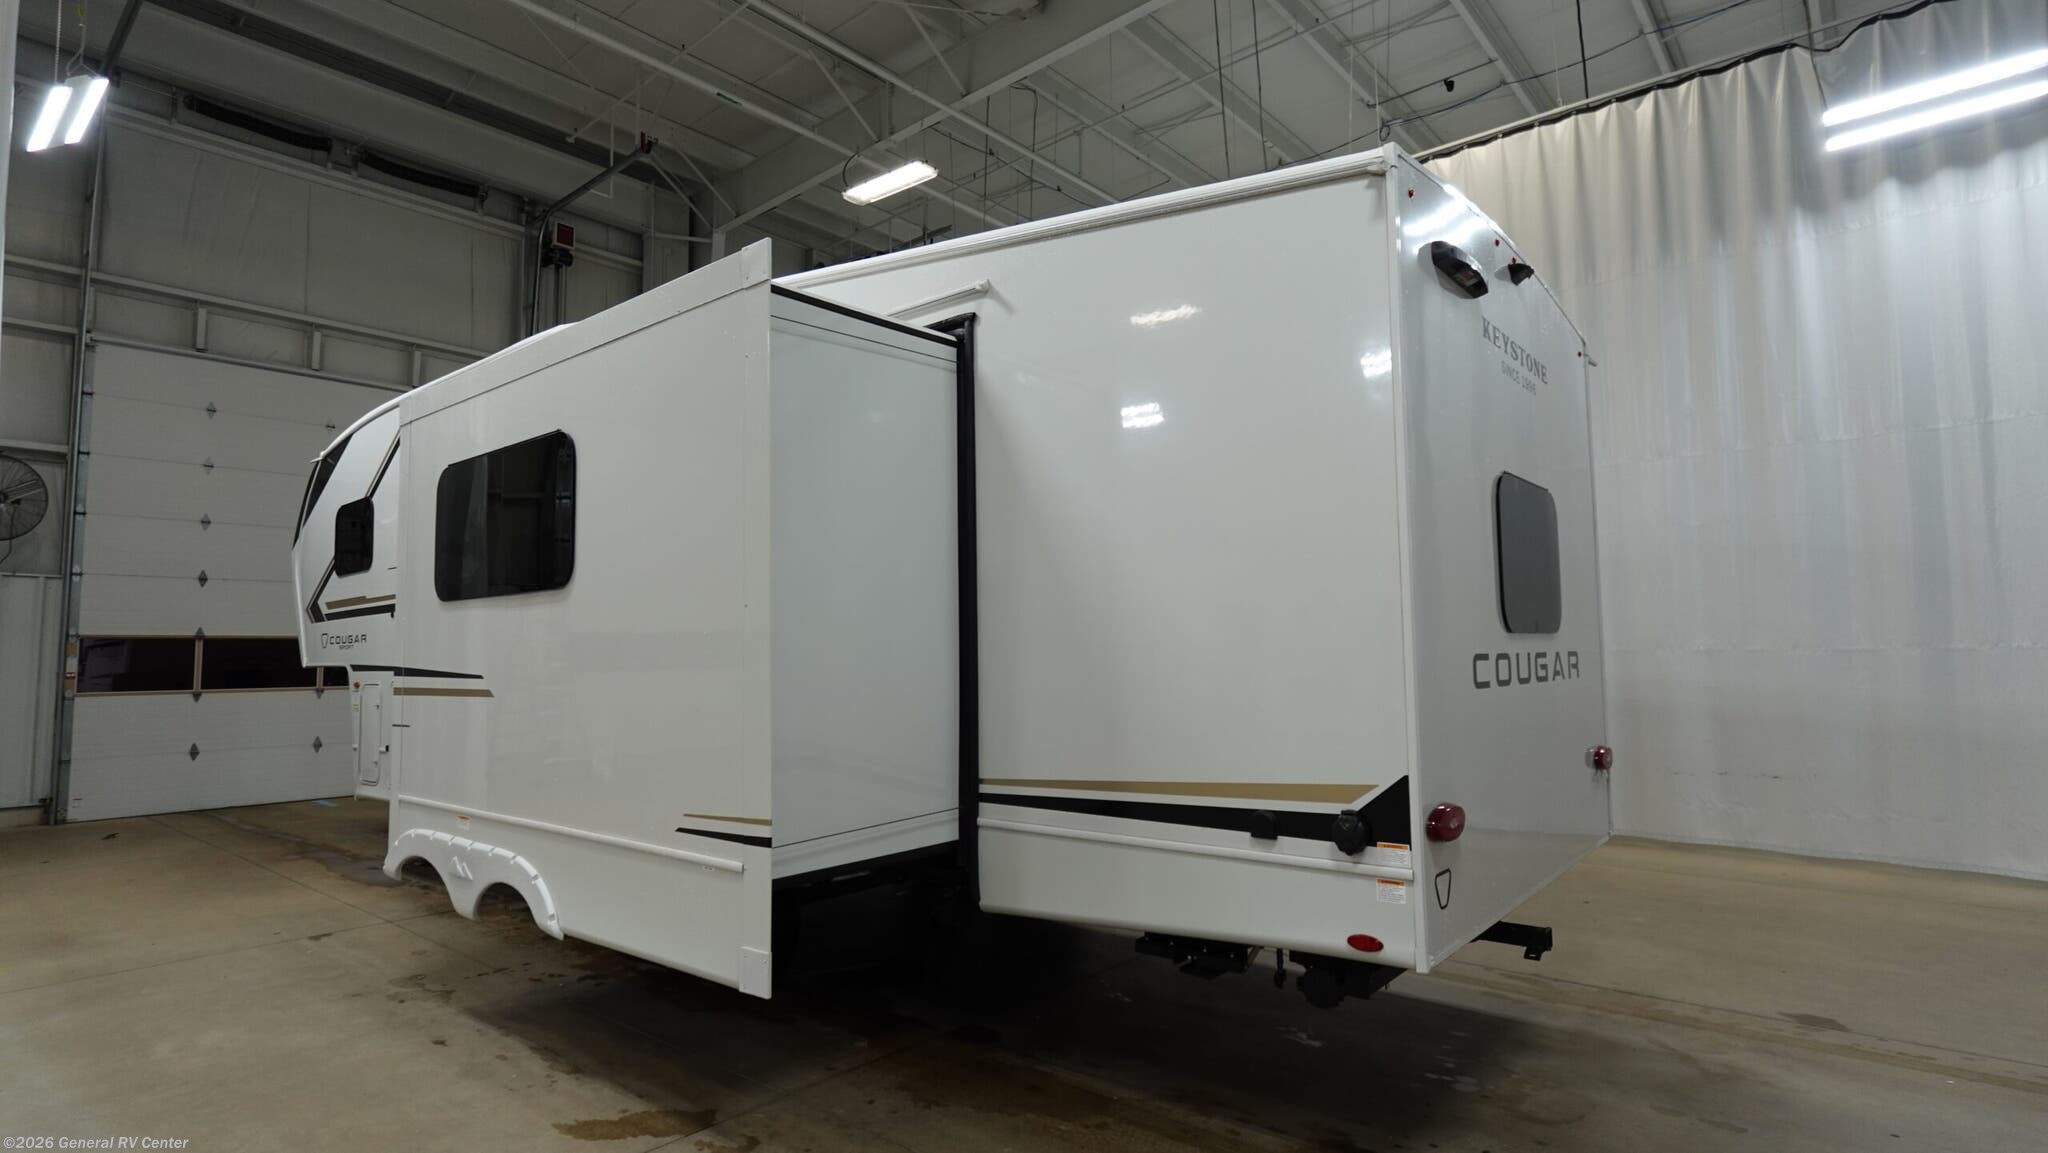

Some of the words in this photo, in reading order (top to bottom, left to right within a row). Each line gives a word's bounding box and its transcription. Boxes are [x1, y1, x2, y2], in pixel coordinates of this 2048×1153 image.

[1481, 315, 1548, 385] KEYSTONE
[1501, 360, 1520, 385] SINCE
[329, 633, 367, 645] COUGAR
[1473, 651, 1580, 690] COUGAR
